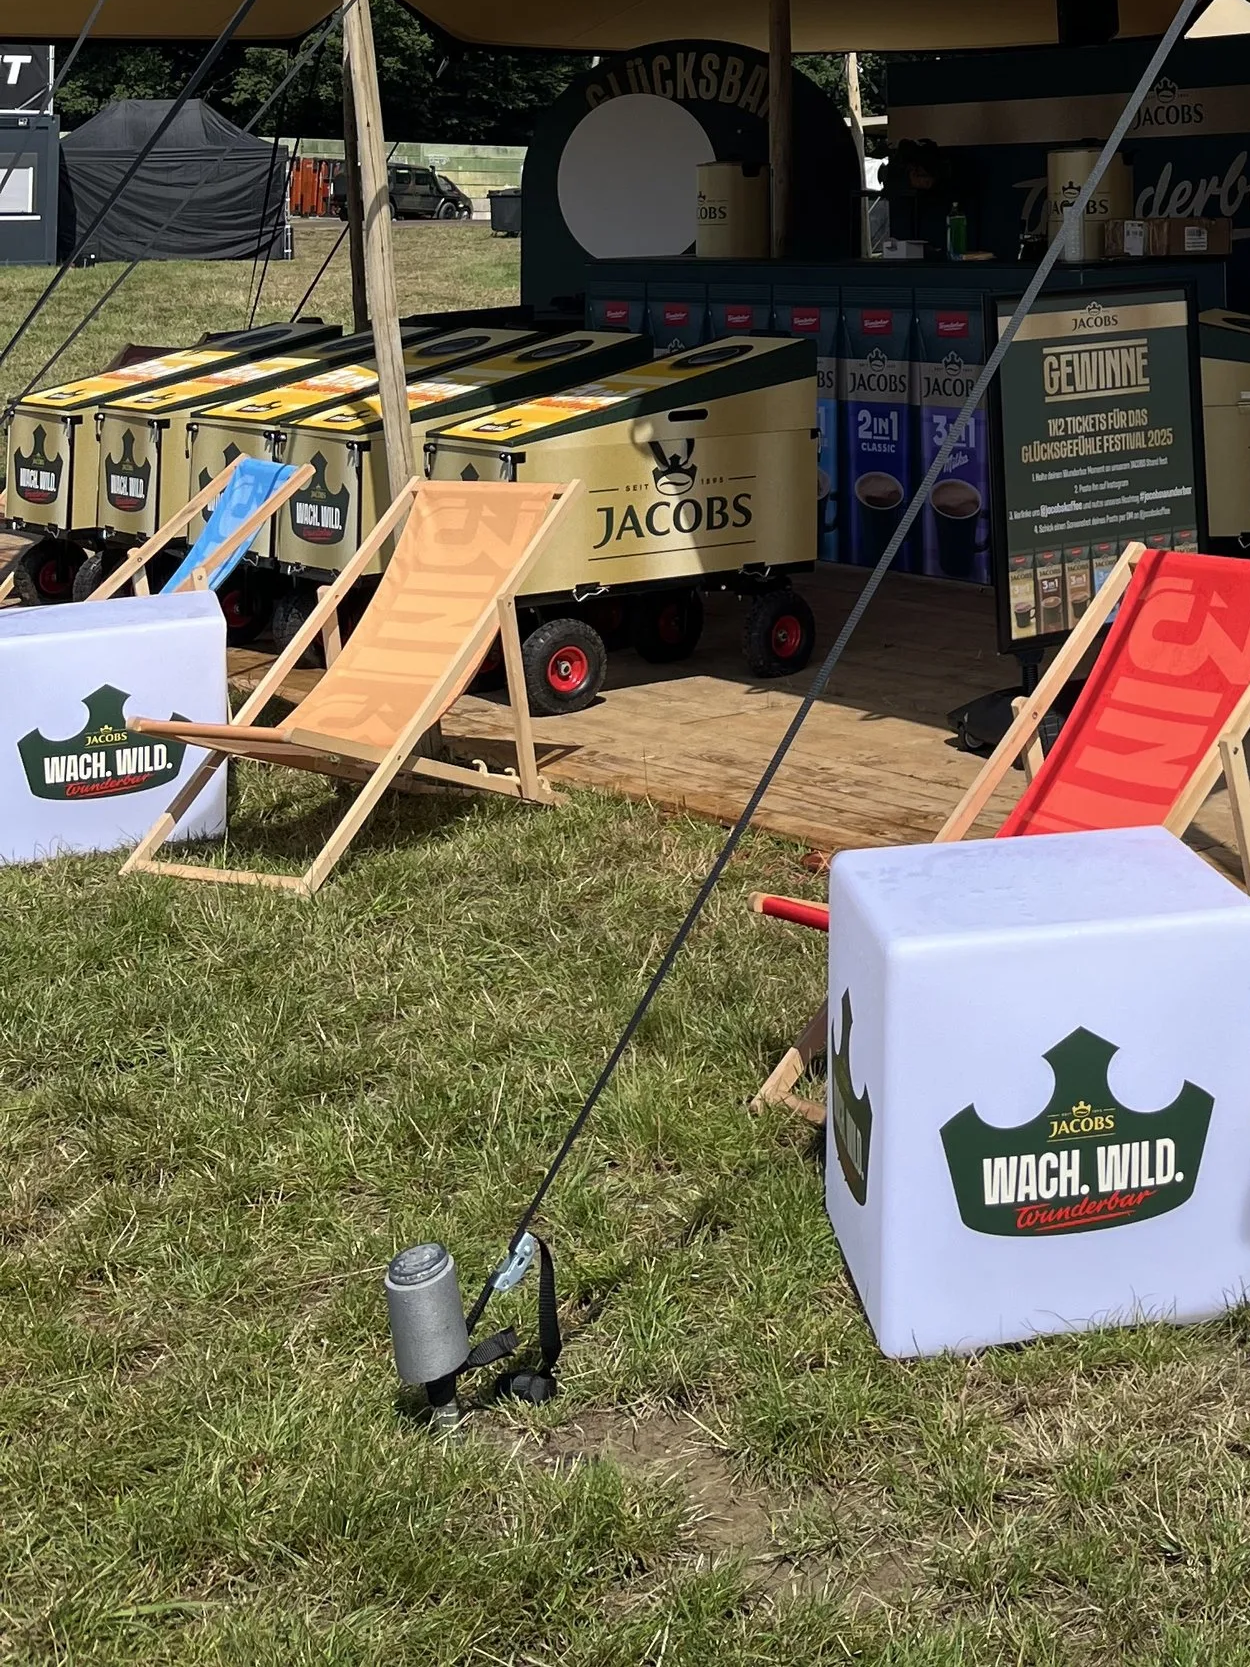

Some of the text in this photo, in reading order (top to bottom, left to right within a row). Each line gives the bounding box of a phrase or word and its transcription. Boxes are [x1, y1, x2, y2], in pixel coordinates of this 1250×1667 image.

[0, 54, 32, 84] T
[585, 52, 770, 118] GLÜCKSBA
[1133, 103, 1204, 130] JACOBS
[1071, 314, 1118, 331] JACOBS
[849, 372, 907, 393] JACOBS
[1042, 346, 1151, 395] GEWINNE
[923, 377, 976, 398] JACOB
[857, 409, 899, 441] 2IN1
[1065, 413, 1107, 435] TICKETS
[1107, 408, 1128, 431] FÜR
[1128, 409, 1149, 428] DAS
[861, 442, 896, 453] CLASSIC
[1021, 428, 1173, 464] GLÜCKSGEFÜHLE FESTIVAL 2025
[625, 476, 724, 492] SEIT 1895
[296, 502, 342, 530] WACH. WILD.
[592, 493, 753, 550] JACOBS
[85, 731, 128, 747] JACOBS
[43, 743, 173, 784] WACH. WILD.
[64, 772, 156, 798] Wunderbar
[1048, 1115, 1115, 1138] JACOBS
[982, 1137, 1184, 1206] WACH. WILD.
[1014, 1189, 1158, 1230] Wunderbar
